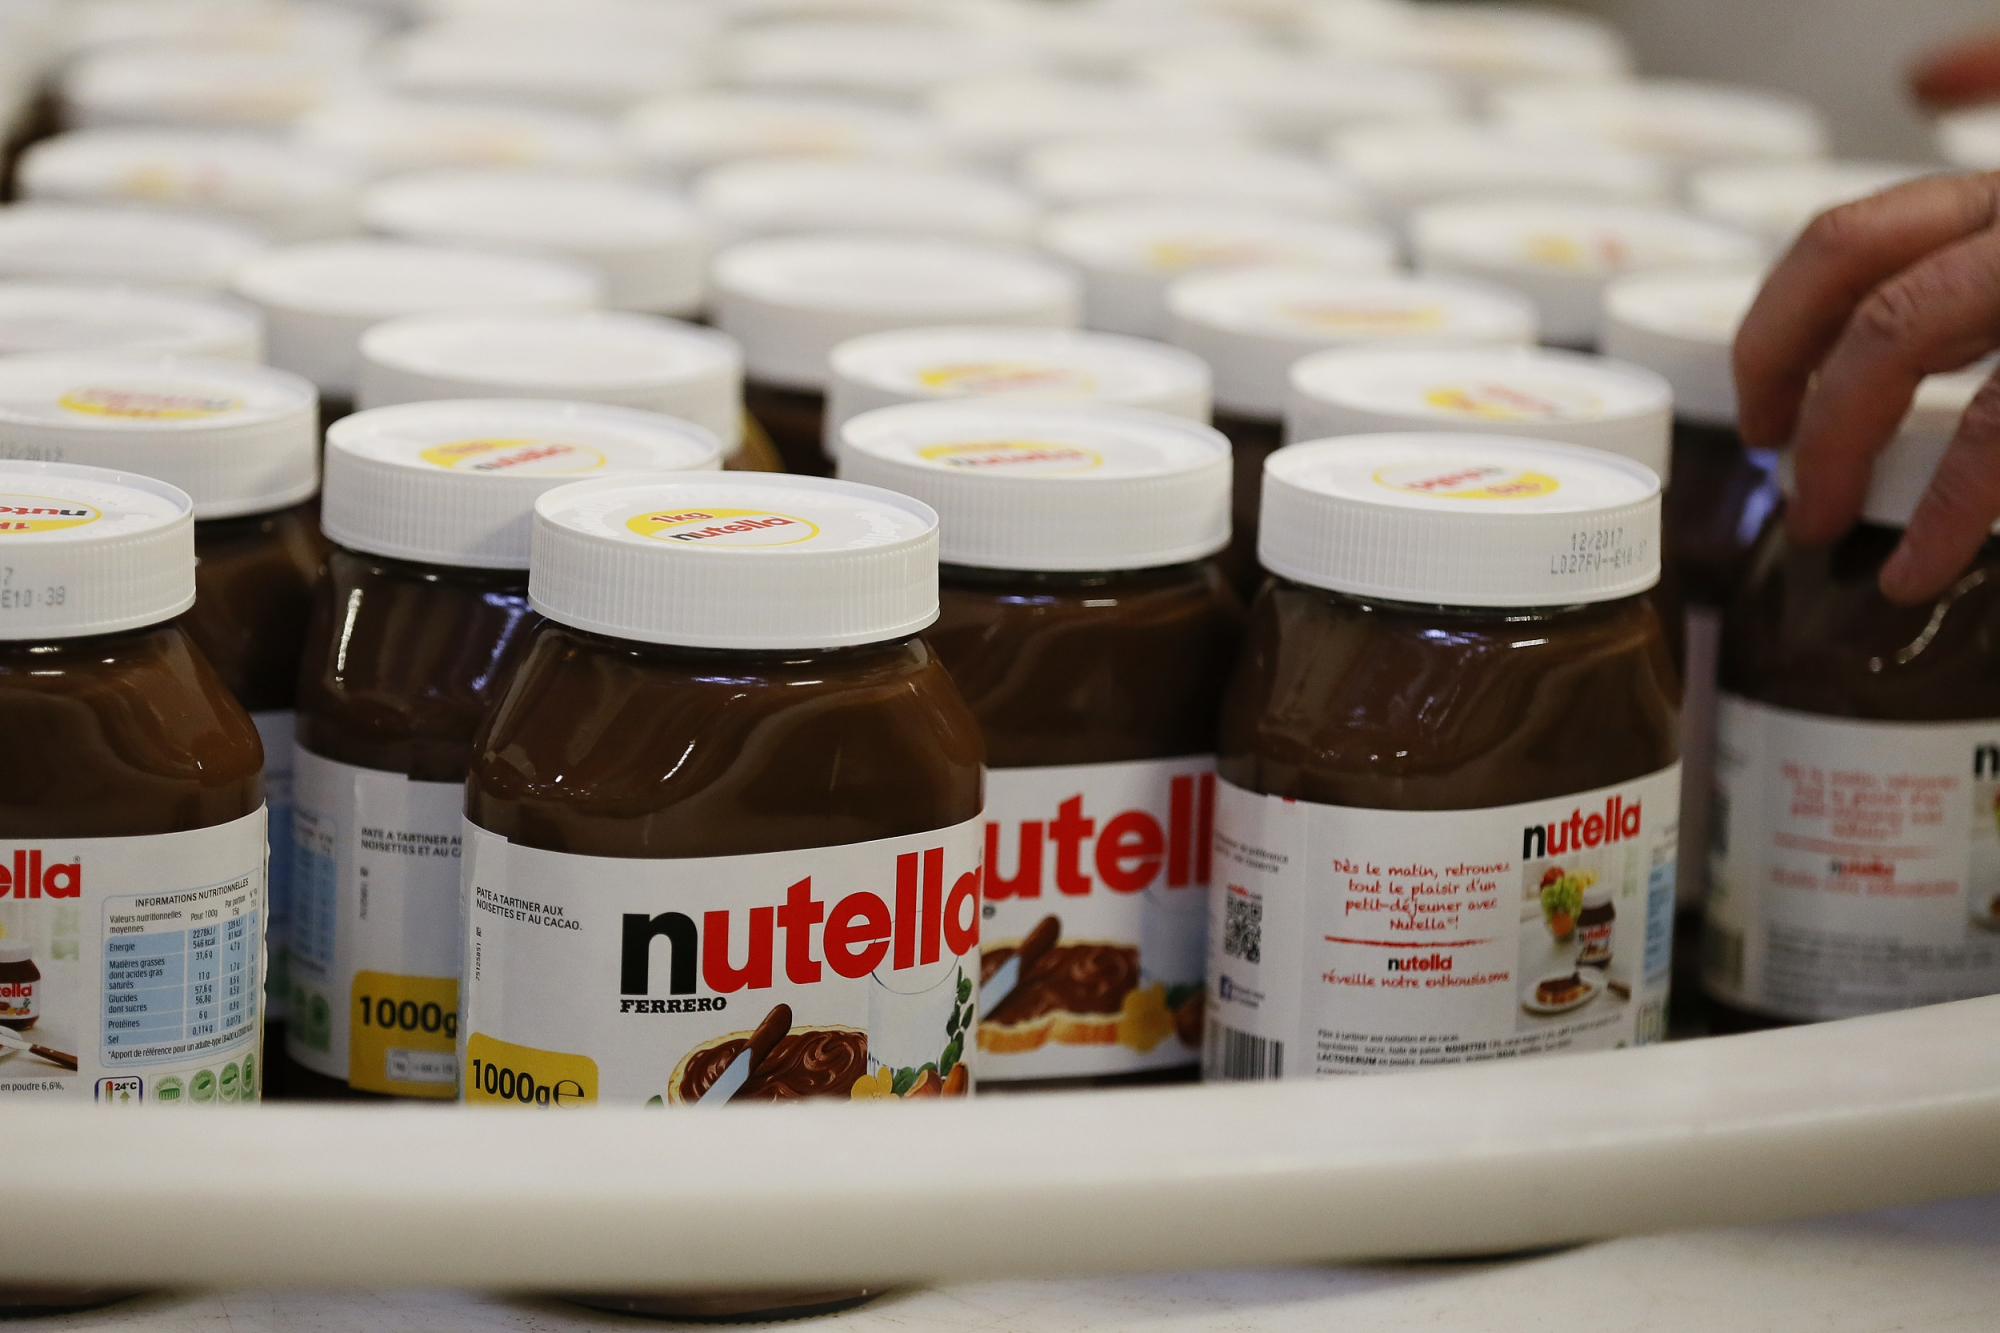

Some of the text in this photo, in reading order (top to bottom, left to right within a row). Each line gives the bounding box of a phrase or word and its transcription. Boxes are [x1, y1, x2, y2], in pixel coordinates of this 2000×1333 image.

[651, 511, 714, 525] 1kg
[668, 516, 797, 541] nutella
[1523, 793, 1642, 861] nutella
[361, 826, 384, 838] PATE
[386, 830, 394, 840] A
[396, 831, 448, 845] TARTINER
[361, 839, 415, 855] NOISETTES
[418, 846, 430, 857] ET
[432, 846, 449, 858] AU
[1333, 857, 1359, 873] Dès
[1366, 862, 1381, 876] le
[1388, 862, 1438, 880] matin,
[135, 892, 197, 907] INFORMATIONS
[199, 877, 249, 900] NUTRITIONNELLES
[1349, 878, 1497, 901] tout le plaisir d'un
[476, 886, 564, 917] PATE A TARTINER AUX
[1345, 897, 1498, 917] petit-déjeuner avec
[110, 910, 182, 924] Valeurs nutritionnelles
[191, 908, 218, 922] Pour 100g
[476, 898, 583, 931] NOISETTES ET AU CACAO.
[620, 846, 982, 997] nutella
[110, 925, 144, 935] moyennes
[109, 942, 136, 952] Energie
[109, 957, 165, 969] Matières grasses
[1388, 953, 1453, 972] nutella
[109, 969, 163, 980] dont acides gras
[1322, 968, 1510, 989] réveille notre enthousiasme
[108, 980, 134, 990] saturés
[108, 993, 138, 1003] Glucides
[620, 996, 728, 1014] FERRERO
[108, 1003, 147, 1013] dont sucres
[108, 1019, 140, 1029] Protéines
[360, 994, 457, 1039] 1000g
[108, 1035, 119, 1044] Sel
[134, 1048, 142, 1058] de
[142, 1045, 172, 1057] référence
[173, 1043, 186, 1054] pour
[0, 1083, 10, 1091] en
[12, 1082, 40, 1092] poudre
[114, 1081, 137, 1091] 24°C
